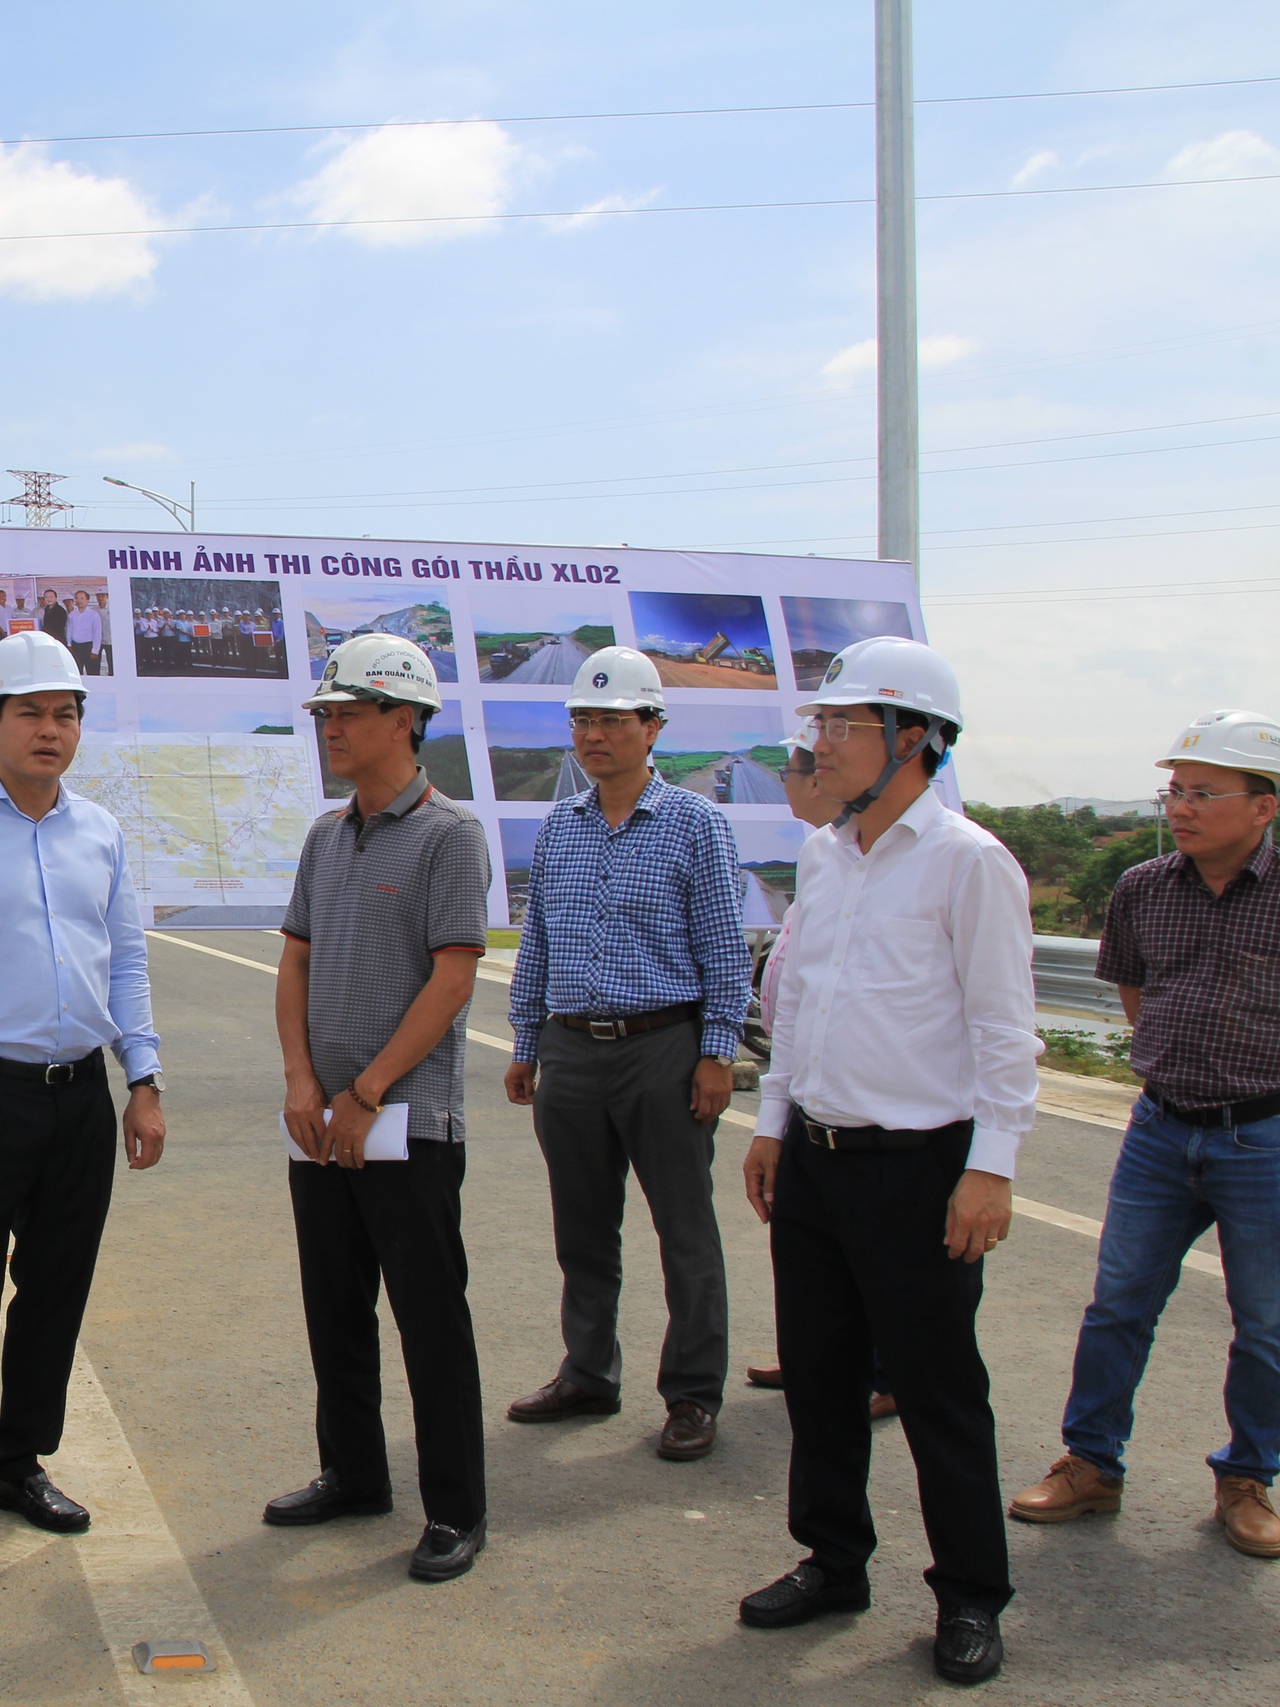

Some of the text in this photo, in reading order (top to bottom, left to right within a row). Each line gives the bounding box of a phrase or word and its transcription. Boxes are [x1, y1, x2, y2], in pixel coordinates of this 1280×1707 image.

[108, 545, 621, 584] HÌNH ẢNH THI CÔNG GÓI THẦU XL02
